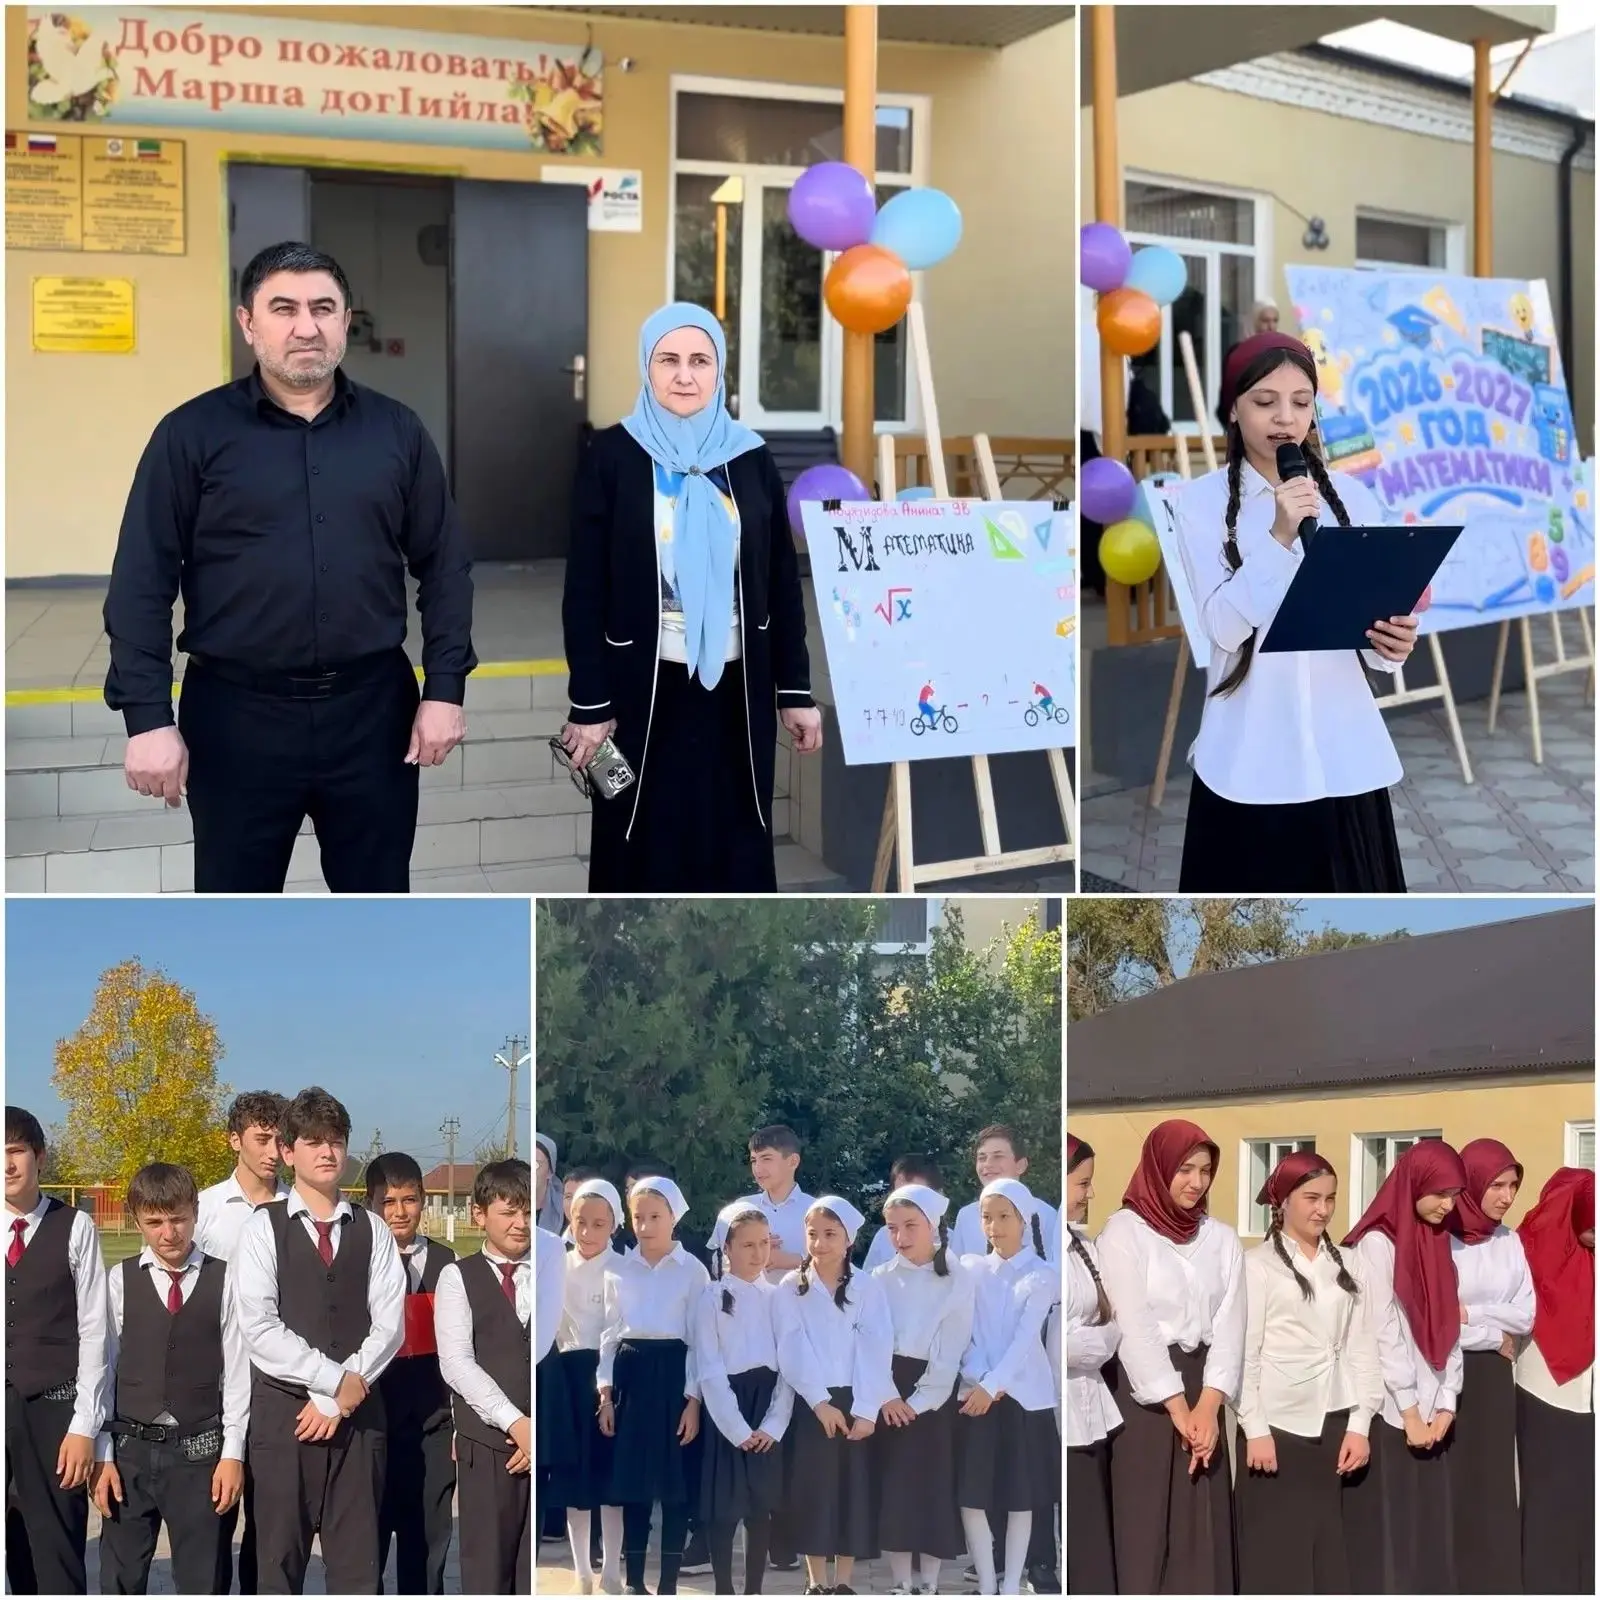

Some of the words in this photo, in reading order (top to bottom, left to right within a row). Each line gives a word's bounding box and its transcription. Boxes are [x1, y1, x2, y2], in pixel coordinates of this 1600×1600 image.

[116, 17, 263, 66] Добро
[277, 38, 548, 83] пожаловать!
[133, 66, 305, 112] Марша
[1358, 361, 1442, 426] 2026
[1451, 360, 1531, 424] 2027
[1418, 408, 1490, 449] ГОД
[1379, 450, 1553, 505] МАТЕМАТИКИ
